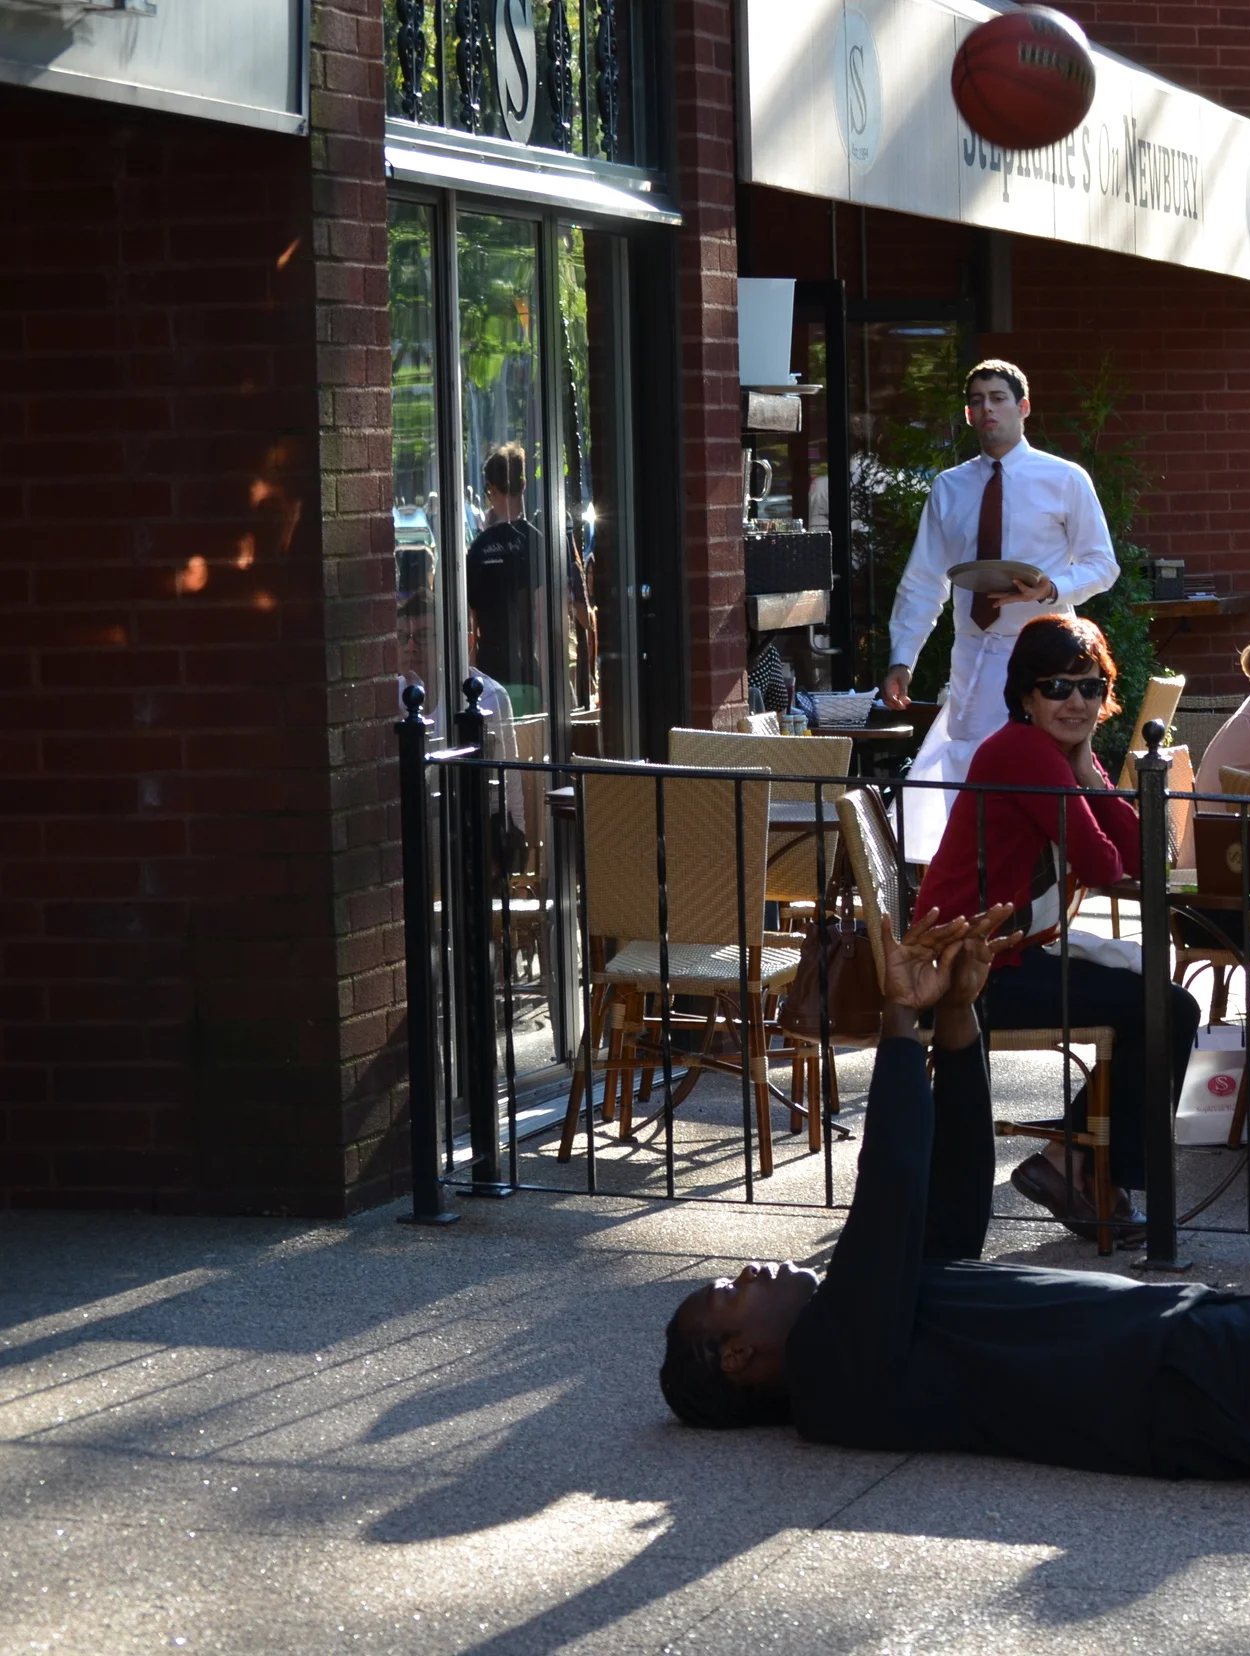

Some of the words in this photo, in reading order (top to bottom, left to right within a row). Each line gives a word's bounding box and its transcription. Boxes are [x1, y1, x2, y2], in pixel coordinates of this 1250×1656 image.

[849, 45, 867, 135] S
[1098, 123, 1120, 198] On
[1122, 114, 1198, 220] NEWBURY
[1215, 1076, 1229, 1091] S
